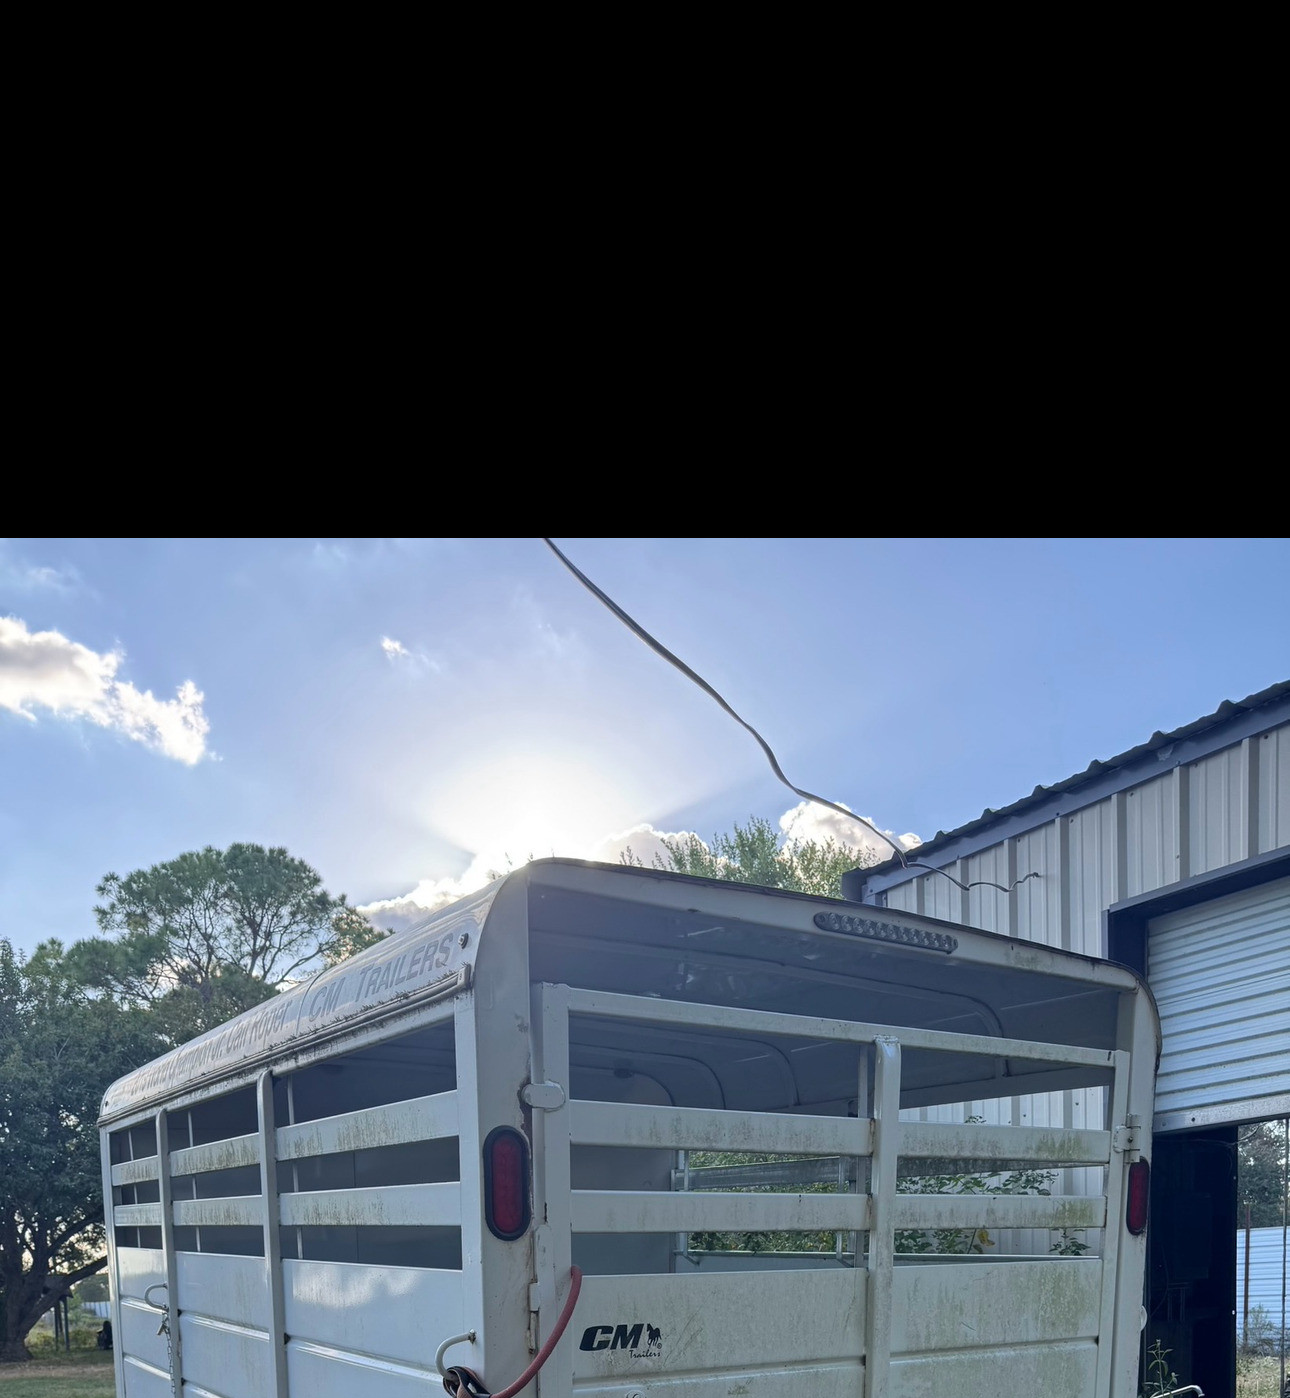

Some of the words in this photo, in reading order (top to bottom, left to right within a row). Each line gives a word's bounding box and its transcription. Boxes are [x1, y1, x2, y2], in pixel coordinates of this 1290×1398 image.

[308, 977, 346, 1022] CM
[249, 999, 292, 1049] Roper
[579, 1323, 645, 1352] CM
[629, 1349, 661, 1359] Trailers
